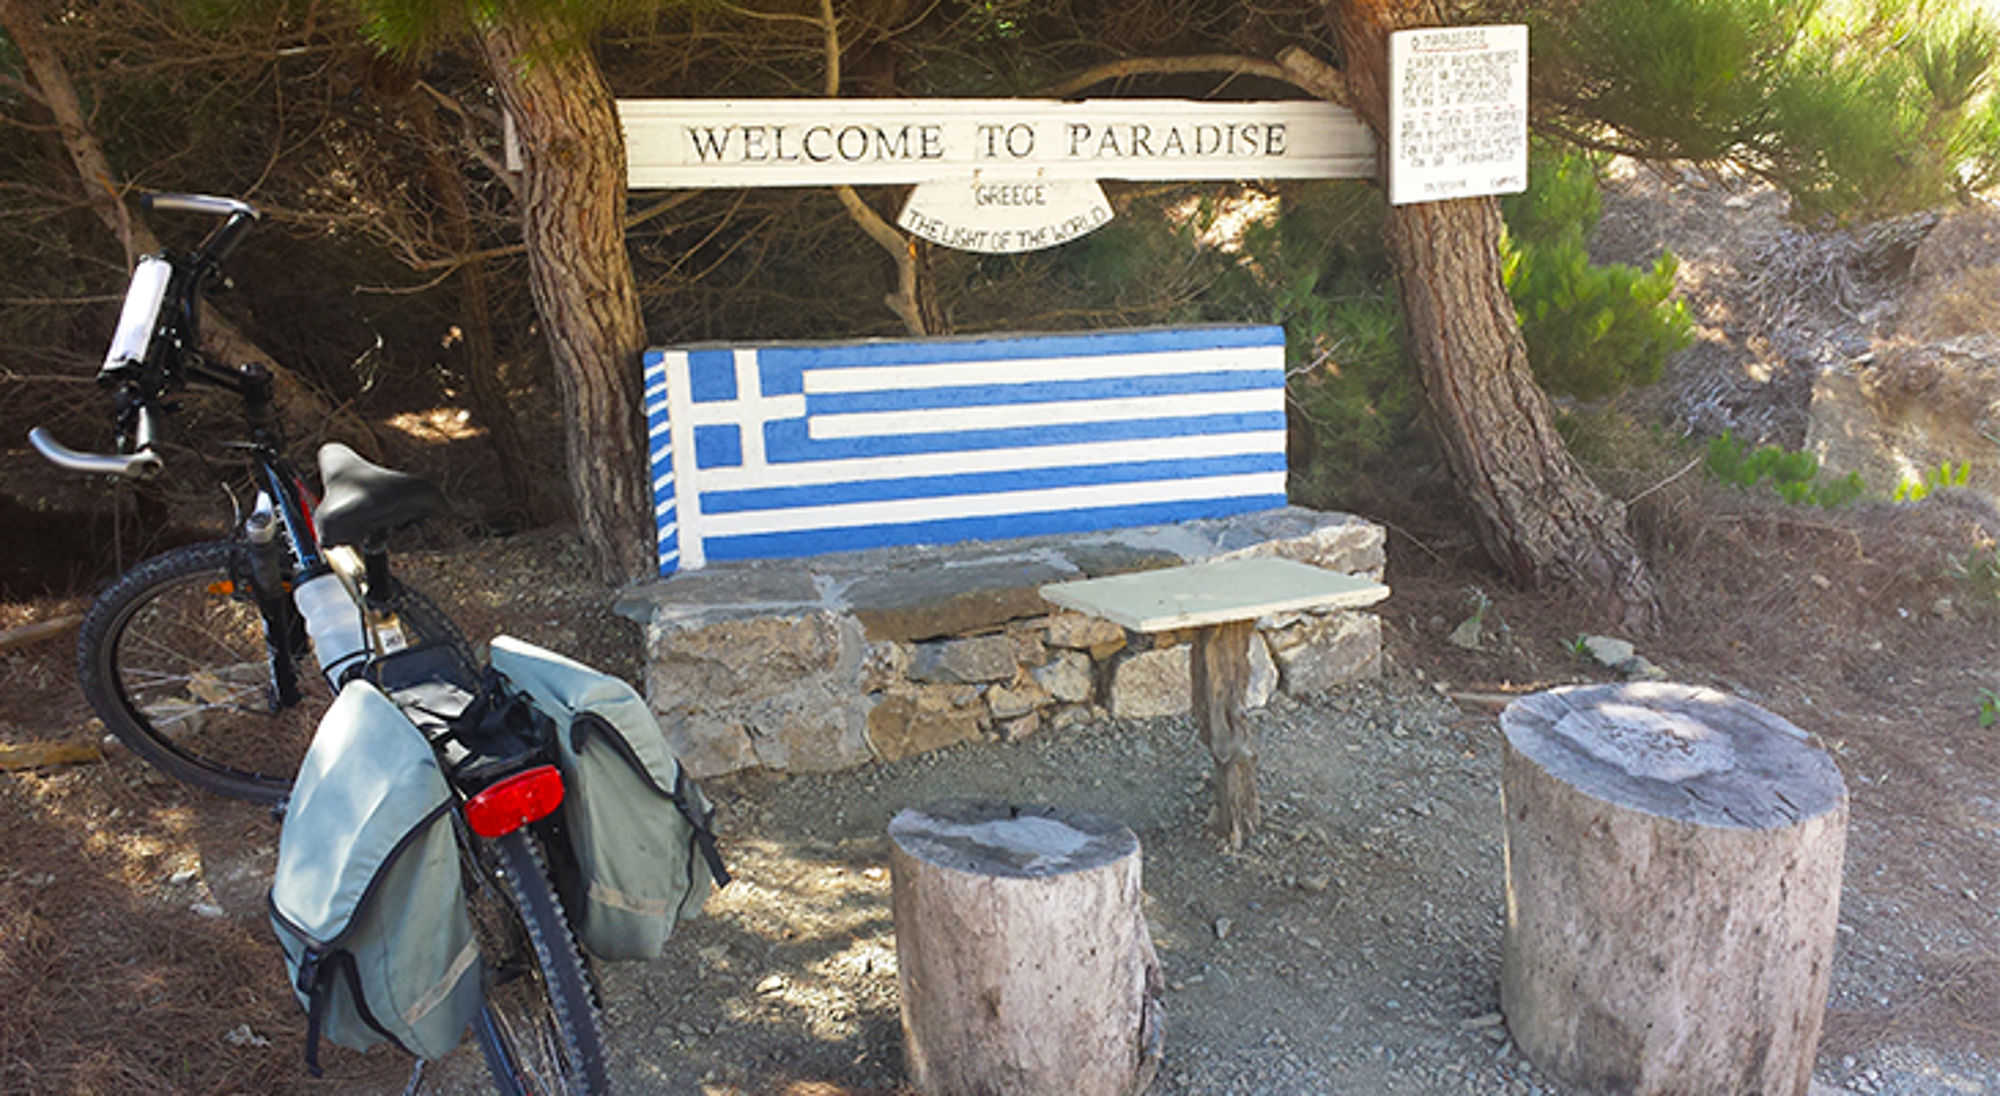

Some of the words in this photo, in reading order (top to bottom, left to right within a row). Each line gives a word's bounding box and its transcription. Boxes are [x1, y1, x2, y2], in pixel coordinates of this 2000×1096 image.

[688, 124, 944, 163] WELCOME
[977, 123, 1035, 158] TO
[1067, 122, 1288, 157] PARADISE
[975, 184, 1047, 206] GREECE
[909, 208, 943, 240] THE
[942, 225, 987, 249] LIGHT
[991, 230, 1012, 250] OF
[1015, 227, 1048, 248] THE
[1050, 205, 1107, 241] WORLD
